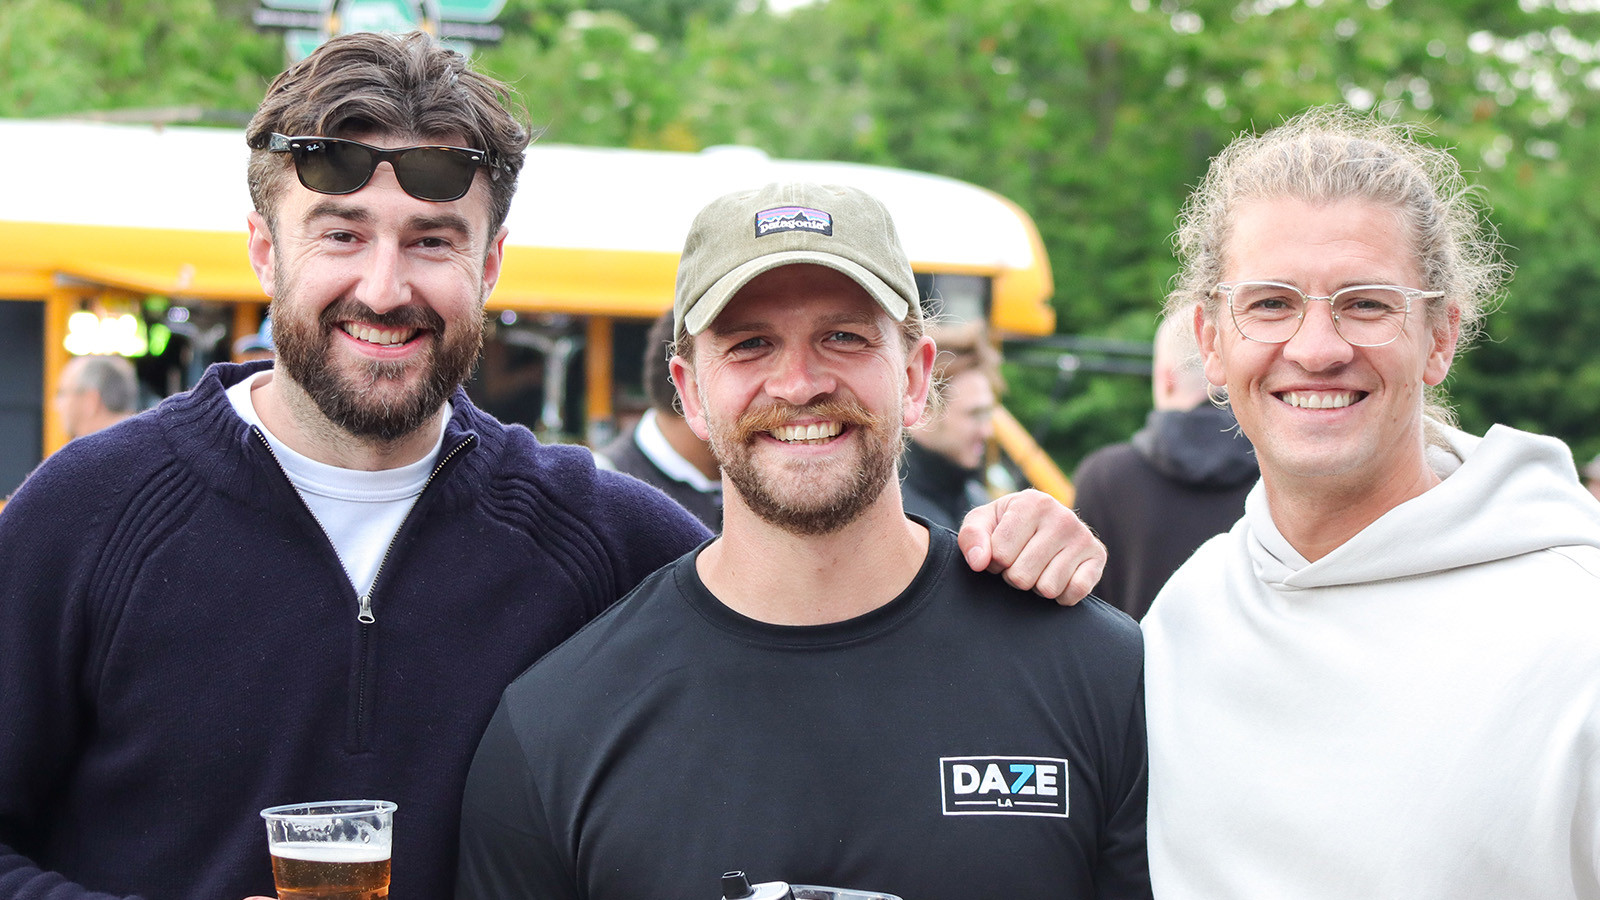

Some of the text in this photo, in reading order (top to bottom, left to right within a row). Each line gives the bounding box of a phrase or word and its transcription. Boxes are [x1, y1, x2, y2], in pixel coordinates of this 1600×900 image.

[760, 219, 825, 234] patagonia
[952, 763, 1058, 796] DAZE
[997, 798, 1013, 808] LA
